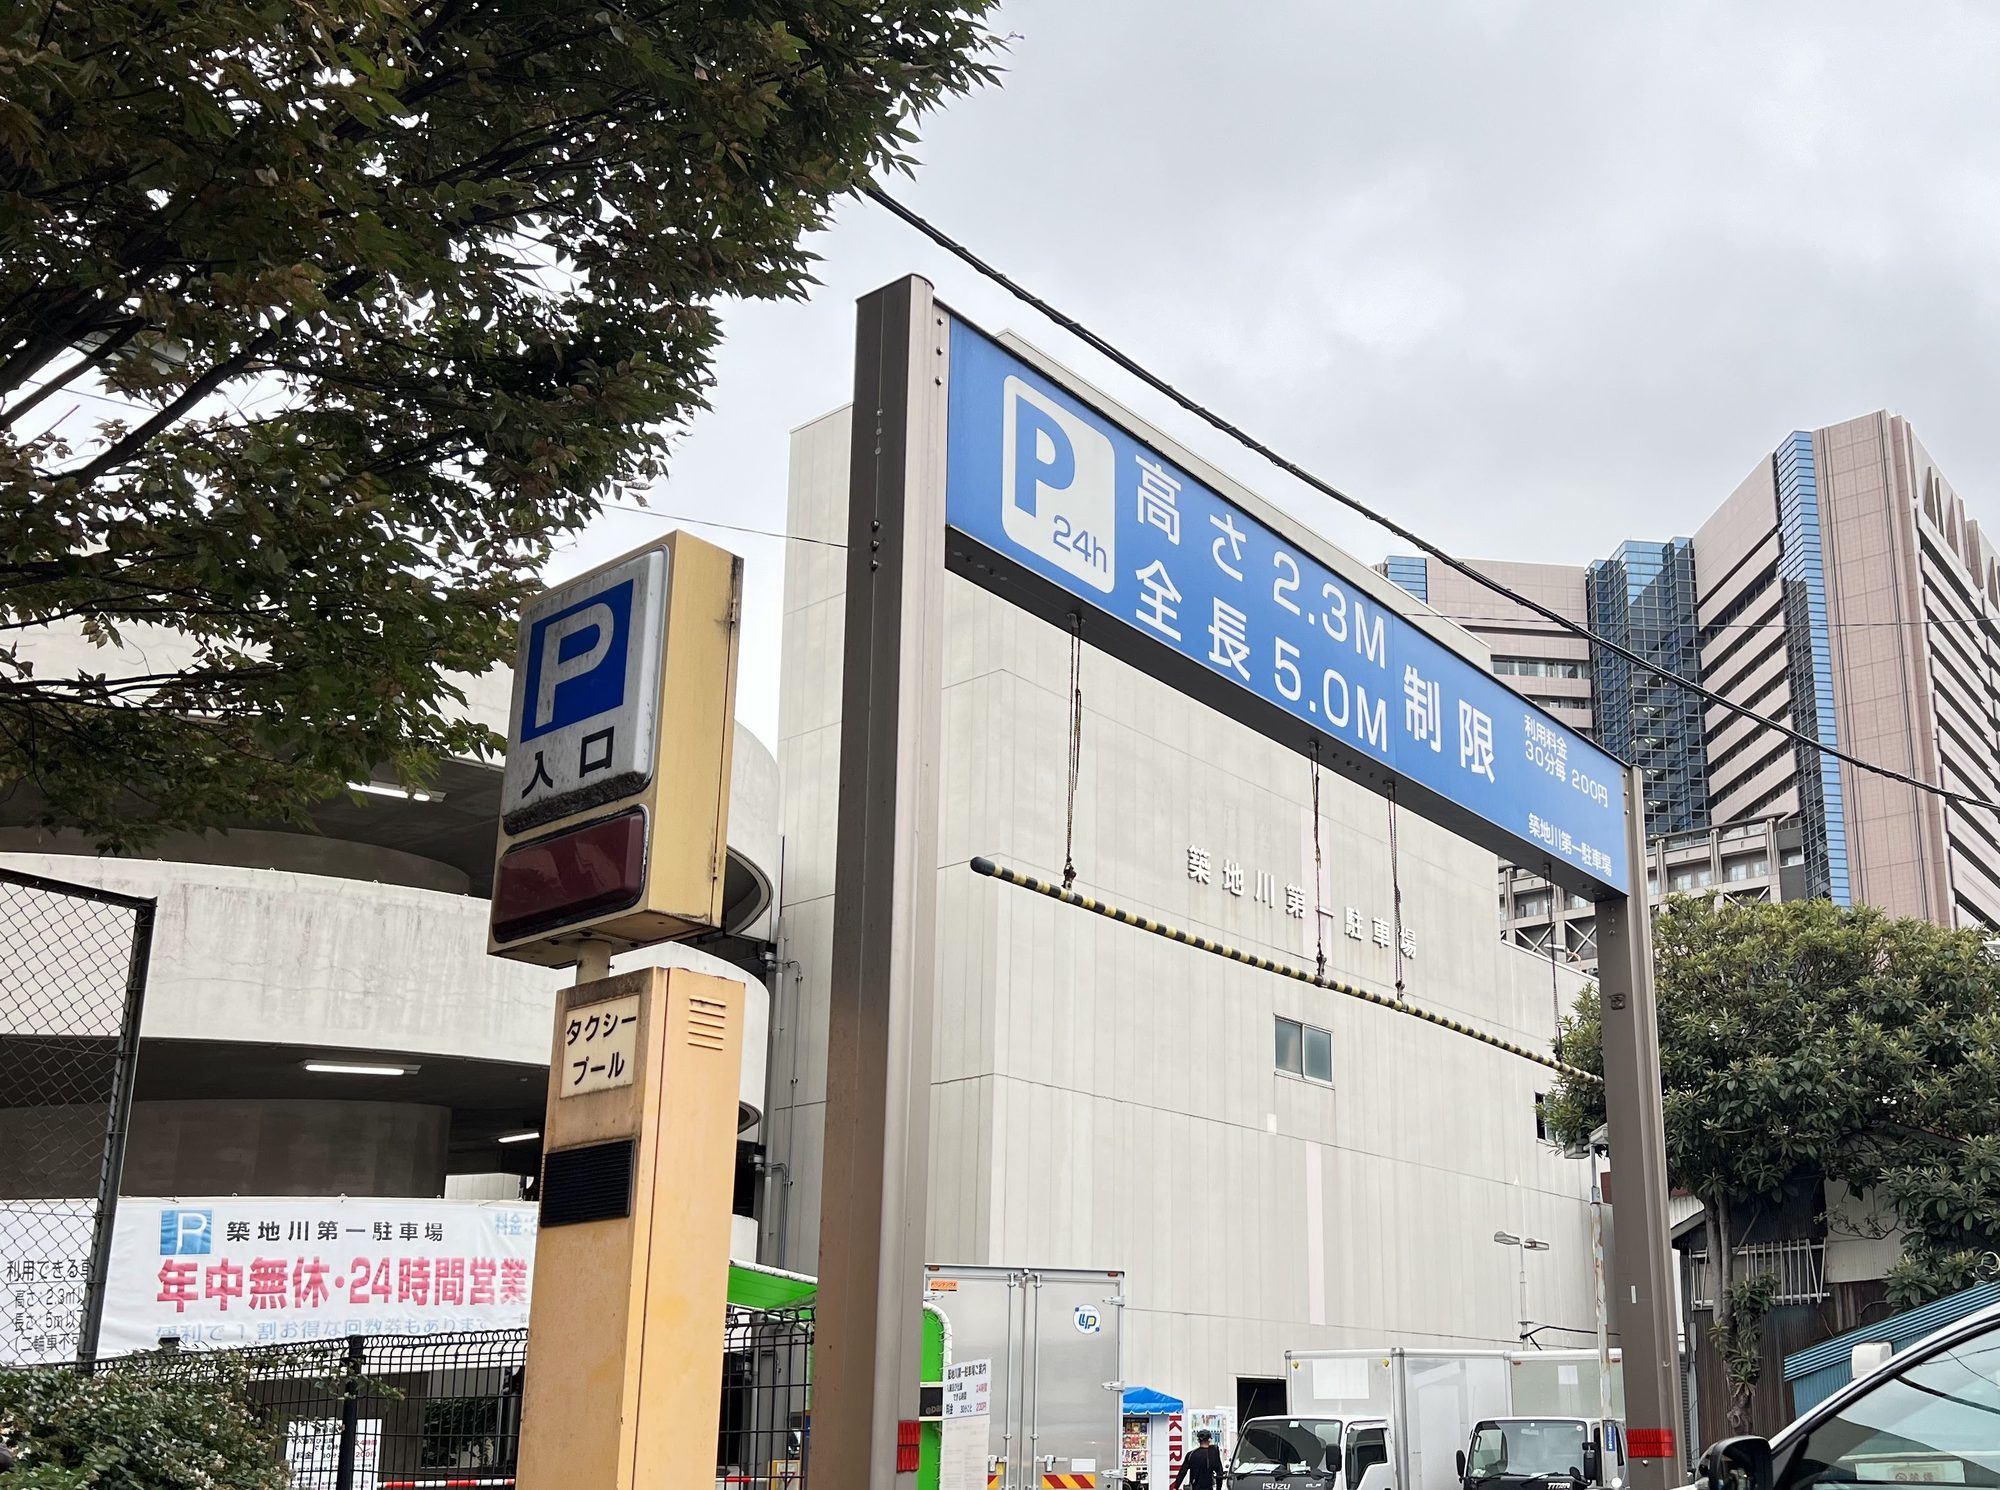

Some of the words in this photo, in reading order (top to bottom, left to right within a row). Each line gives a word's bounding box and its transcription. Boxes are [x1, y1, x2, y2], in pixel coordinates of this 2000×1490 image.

[1014, 392, 1076, 519] P
[1052, 514, 1107, 573] 24h
[534, 602, 615, 729] P
[1402, 663, 1496, 784] 制限
[1523, 714, 1569, 762] 利用料金
[521, 725, 615, 799] 入口
[1524, 740, 1567, 783] 30分毎
[1571, 769, 1609, 809] 200円
[1528, 812, 1613, 878] 築地川第一駐車場
[1186, 844, 1417, 960] 築地川第一駐車場
[566, 1012, 637, 1047] タクシー
[572, 1051, 626, 1086] プール
[226, 1219, 444, 1242] 築地川第一駐車場
[156, 1255, 528, 1313] 年中無休・24時間営業
[1262, 1482, 1291, 1490] ISUZU
